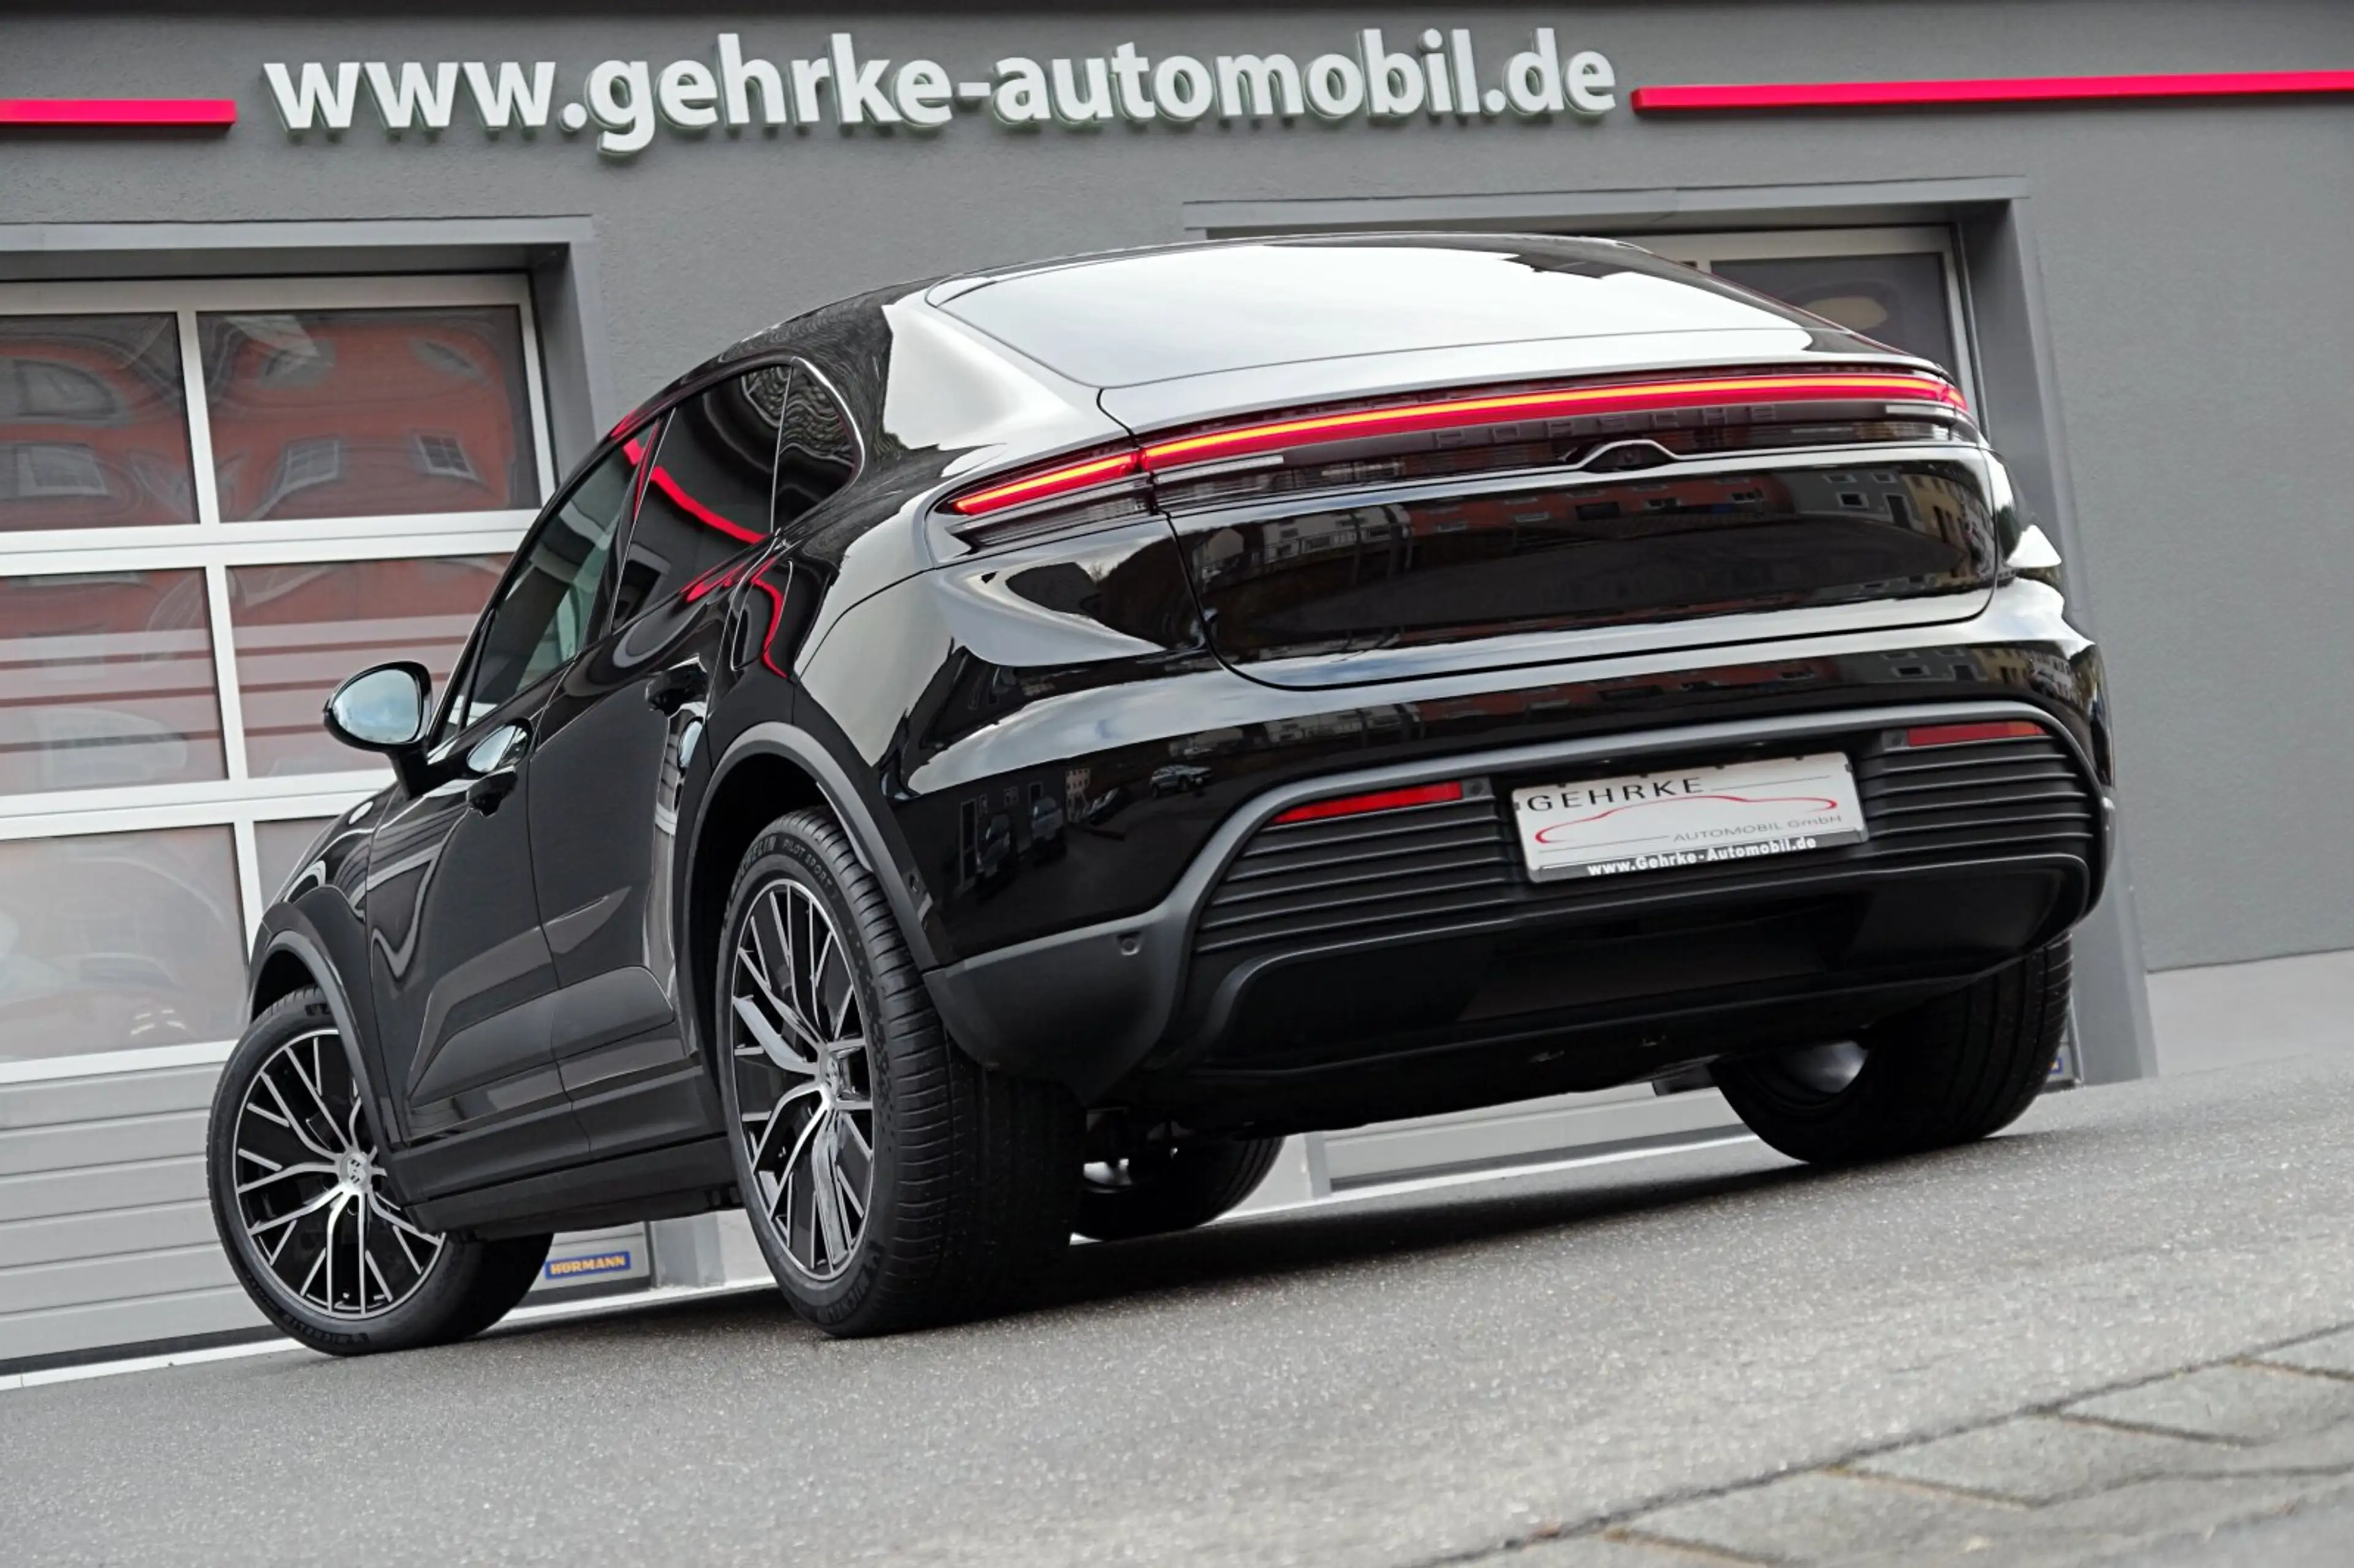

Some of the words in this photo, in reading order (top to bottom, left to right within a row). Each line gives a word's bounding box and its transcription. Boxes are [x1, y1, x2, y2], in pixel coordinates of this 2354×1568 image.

[263, 28, 1617, 154] www.gehrke-automobil.de
[1433, 404, 1777, 450] PORSCHE
[1527, 777, 1705, 812] GEHRKE
[1673, 822, 1783, 843] AUTOMOBIL
[1787, 815, 1842, 829] GmbH
